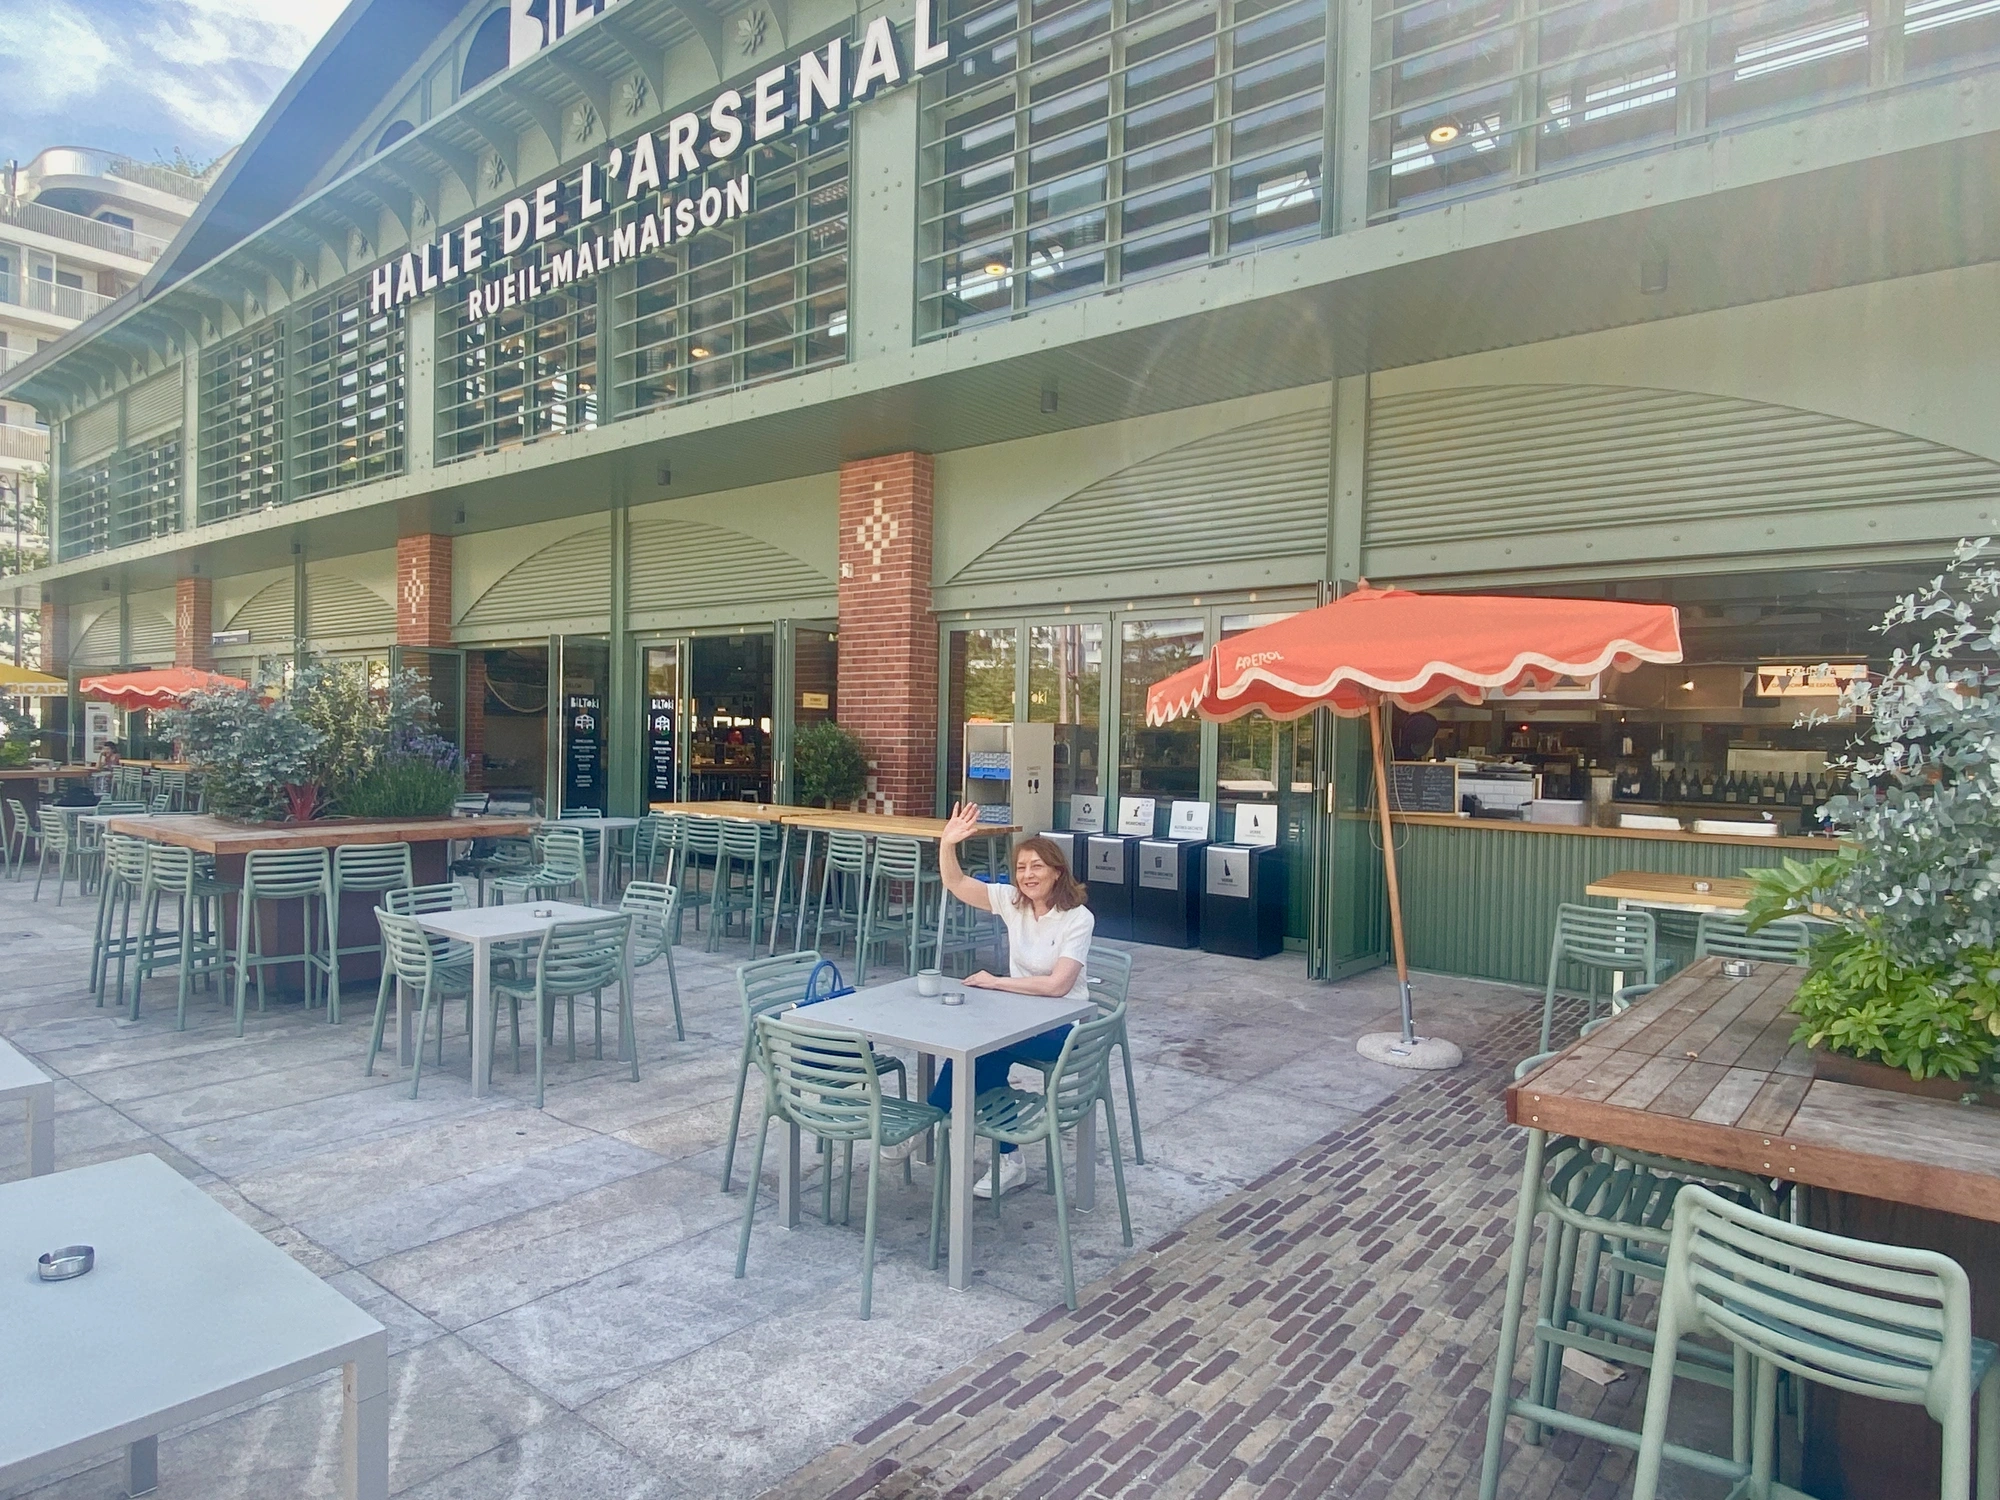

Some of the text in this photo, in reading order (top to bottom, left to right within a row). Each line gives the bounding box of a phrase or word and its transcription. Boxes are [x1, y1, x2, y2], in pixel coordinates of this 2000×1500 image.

[370, 0, 949, 315] HALLE DE L'ARSENAL
[469, 173, 750, 322] RUEIL-MALMAISON
[1235, 651, 1285, 671] APEROL
